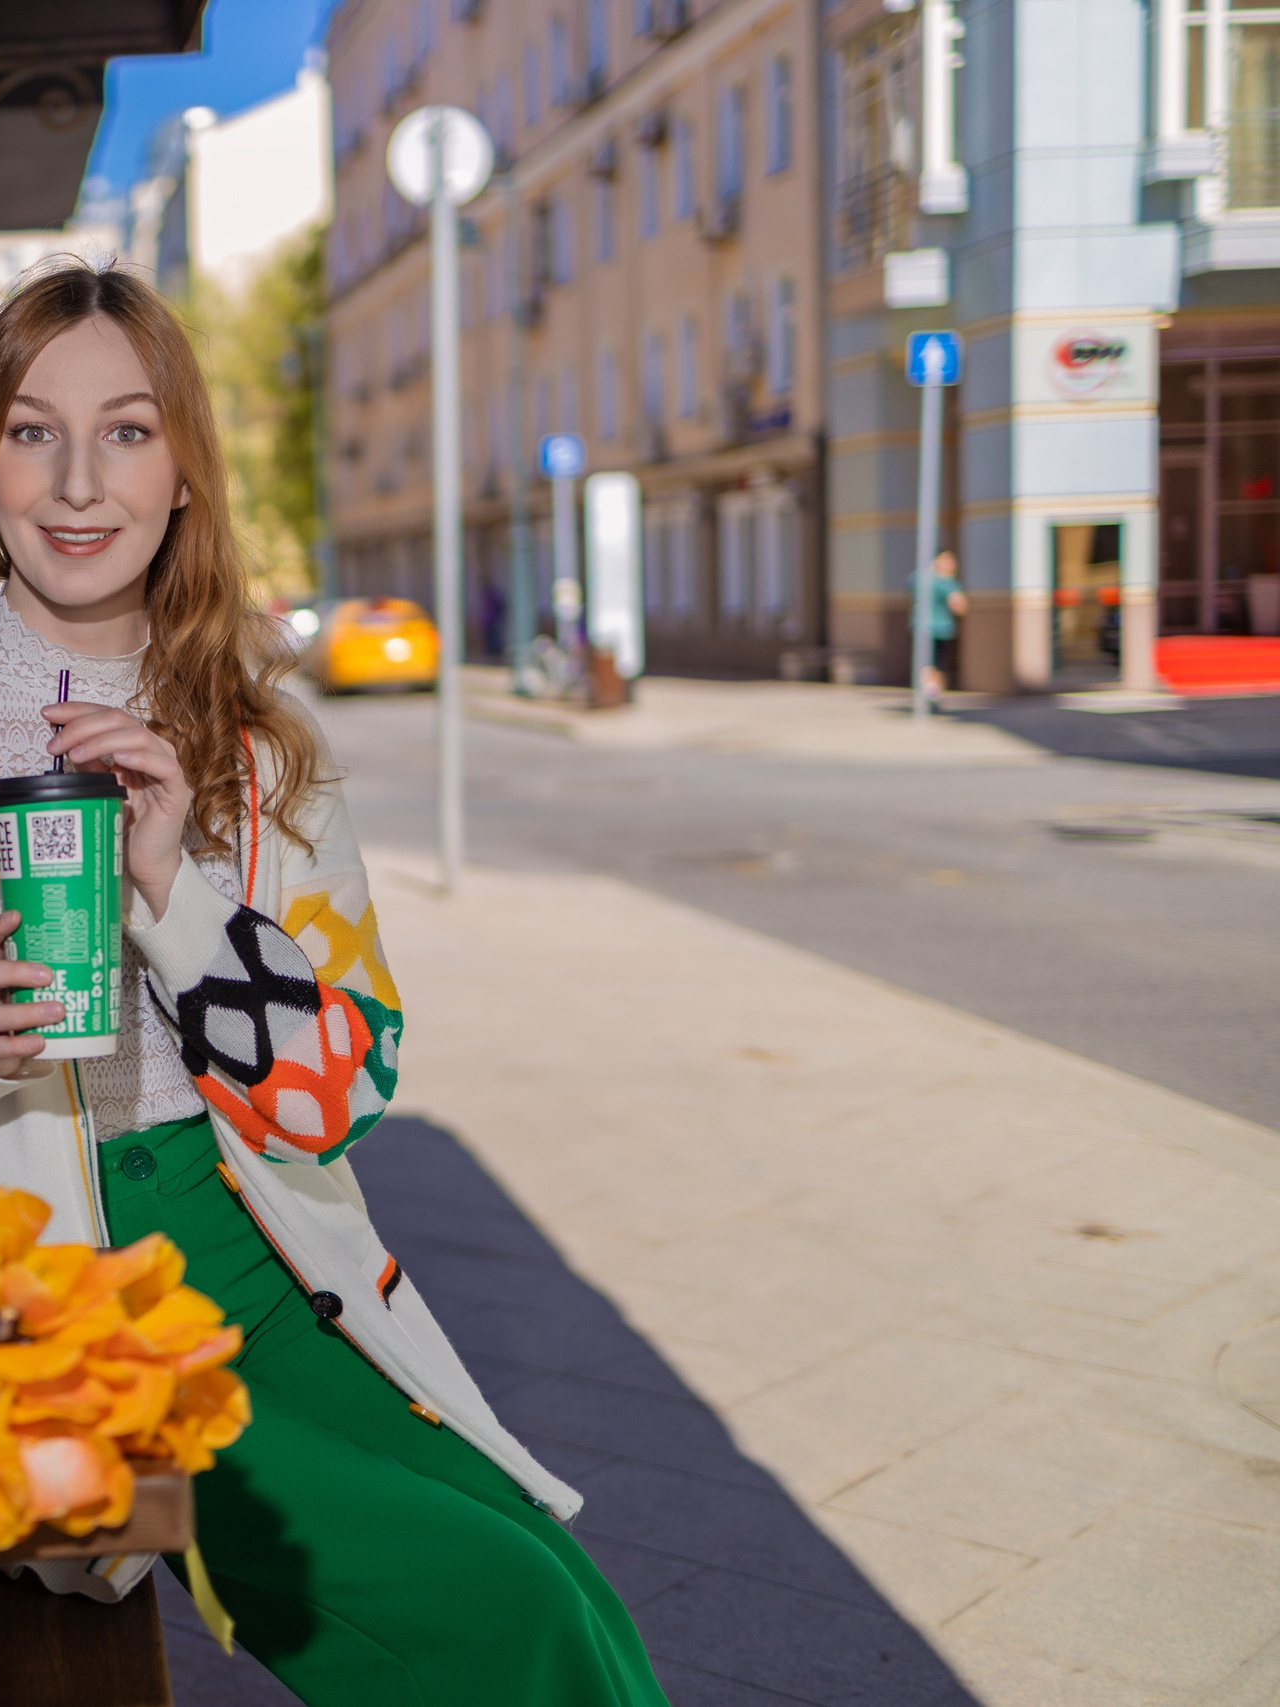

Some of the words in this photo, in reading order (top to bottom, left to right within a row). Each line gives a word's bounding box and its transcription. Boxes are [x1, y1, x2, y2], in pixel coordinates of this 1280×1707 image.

[24, 923, 45, 963] ONE
[42, 884, 67, 963] MILLION
[65, 908, 89, 963] LIKES
